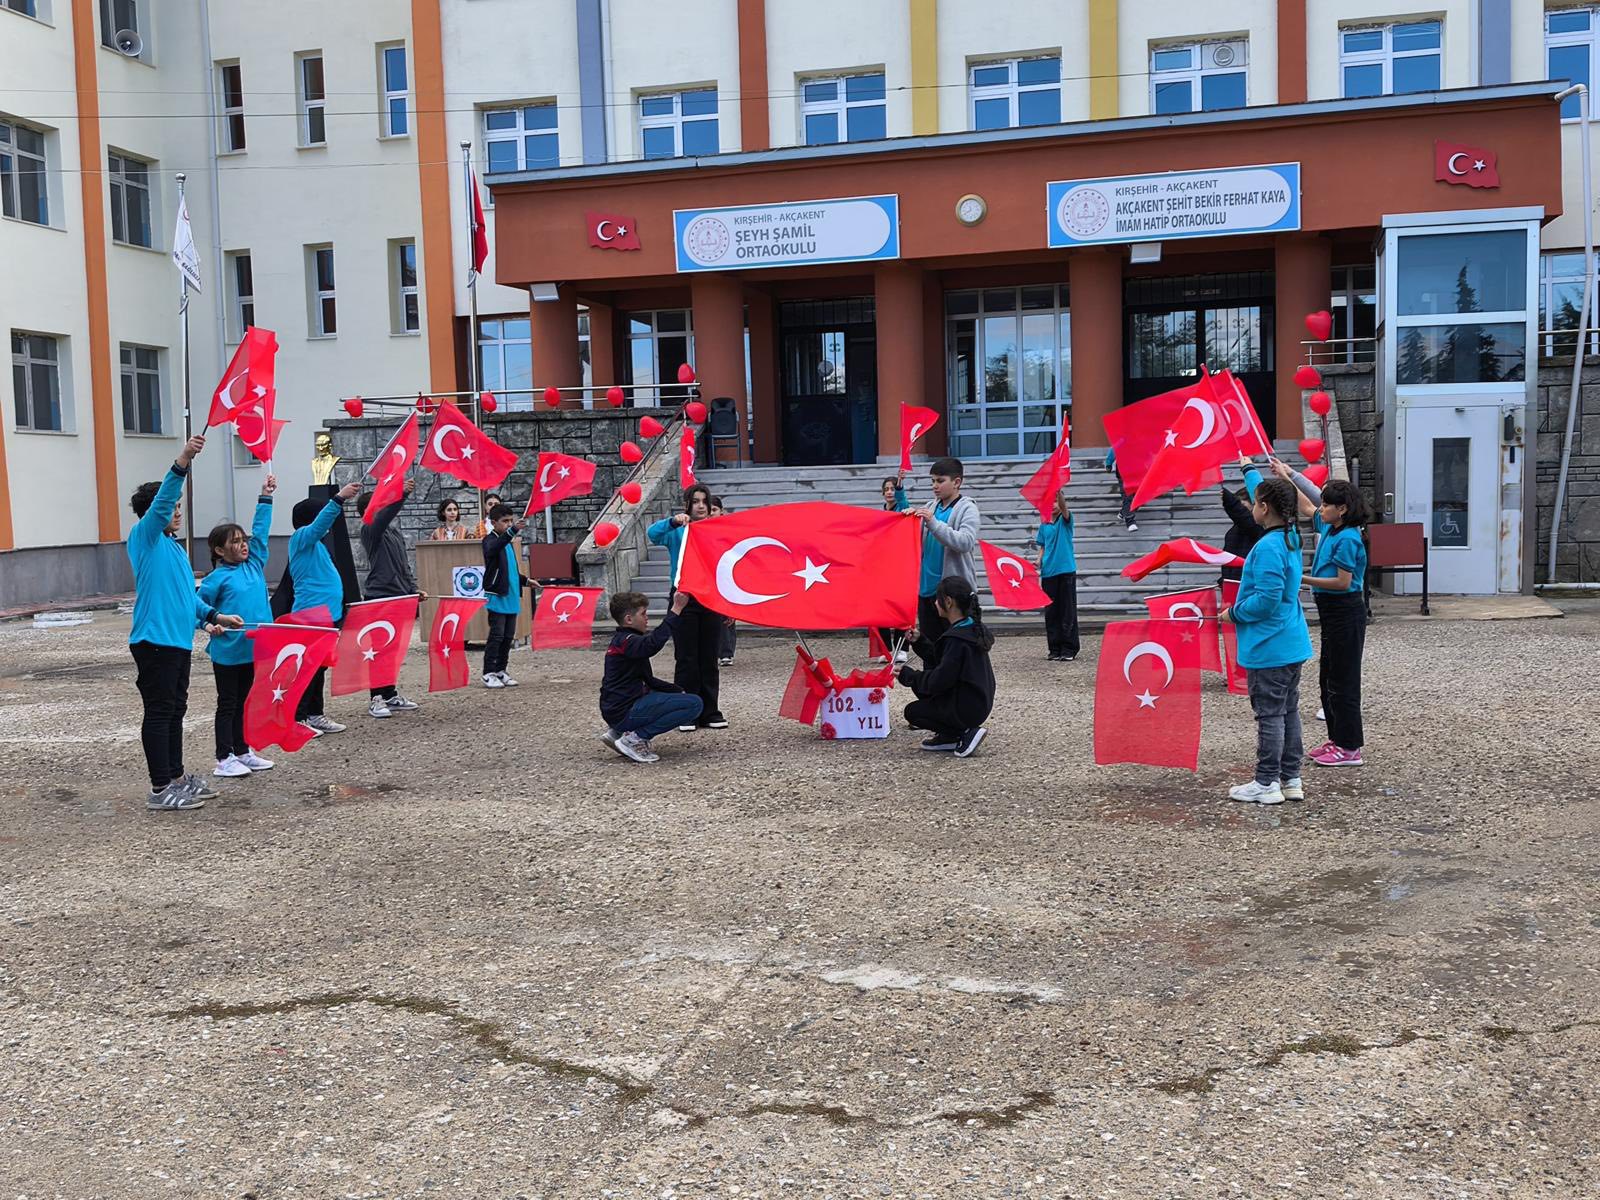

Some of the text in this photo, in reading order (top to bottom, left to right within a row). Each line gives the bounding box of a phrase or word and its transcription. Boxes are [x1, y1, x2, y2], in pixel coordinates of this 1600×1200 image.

[1115, 184, 1158, 197] KIRŞEHİR
[1166, 179, 1219, 193] AKÇAKENT
[1115, 190, 1286, 217] AKÇAKENT ŞEHİT BEKİR FERHAT KAYA
[734, 213, 773, 226] KIRŞEHİR
[779, 210, 826, 222] AKÇAKENT
[1116, 212, 1227, 232] İMAM HATİP ORTAOKULU
[735, 223, 815, 245] ŞEYH ŞAMİL
[736, 241, 816, 259] ORTAOKULU
[828, 696, 861, 713] 102.
[857, 716, 883, 730] YIL
